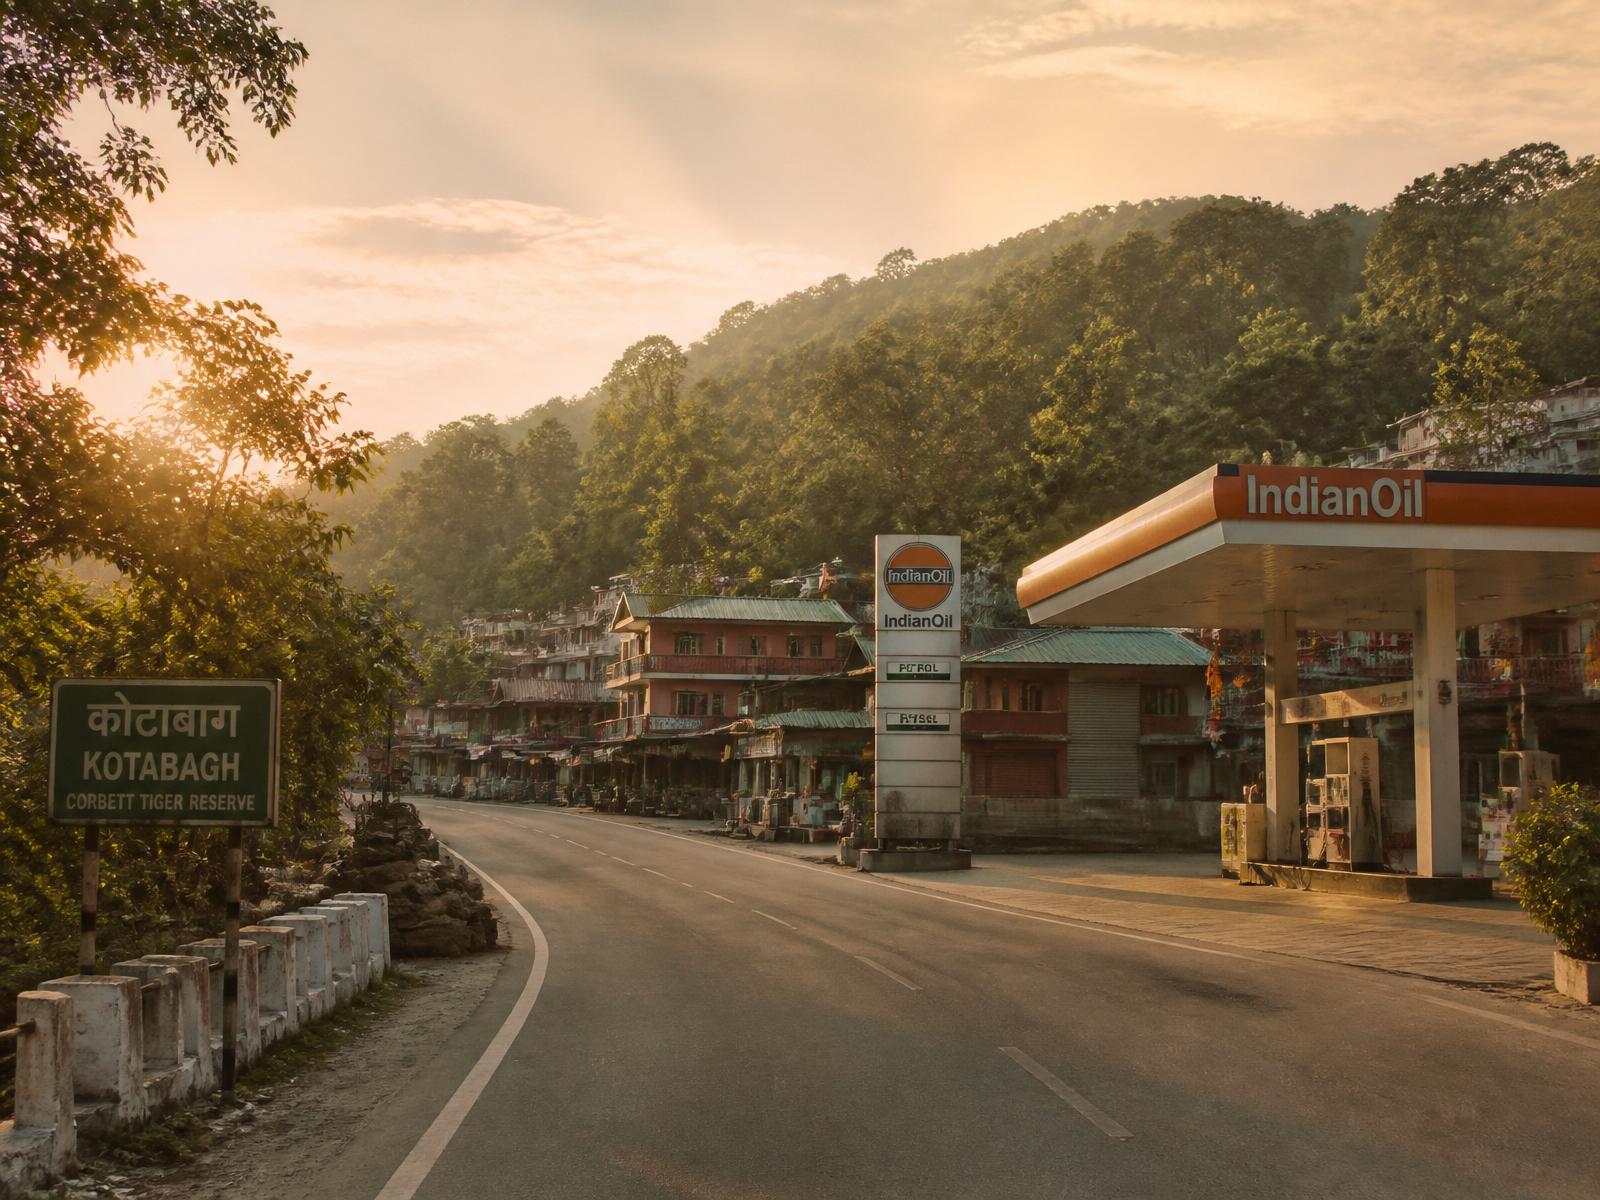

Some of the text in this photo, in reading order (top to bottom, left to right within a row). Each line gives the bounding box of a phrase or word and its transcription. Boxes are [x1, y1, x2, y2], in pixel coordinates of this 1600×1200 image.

[1247, 474, 1423, 518] IndianOil
[888, 569, 951, 583] IndianOil
[884, 614, 953, 628] IndianOil
[86, 691, 241, 738] कोटाबाग
[82, 751, 240, 782] KOTABAGH
[66, 793, 256, 811] CORBETT TIGER RESERVE
